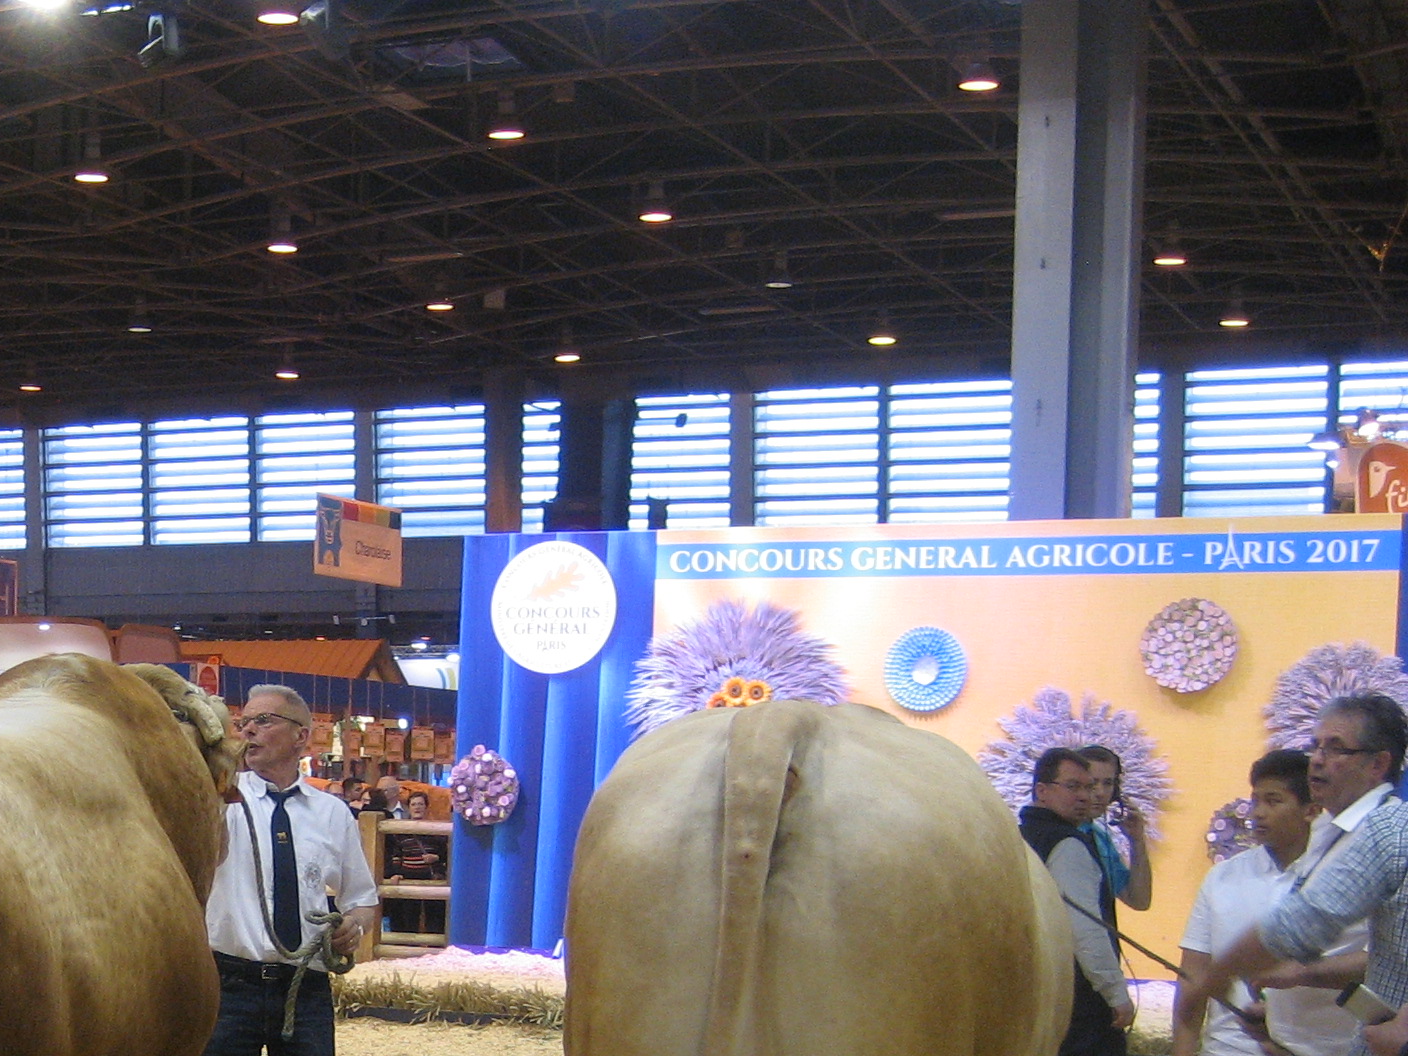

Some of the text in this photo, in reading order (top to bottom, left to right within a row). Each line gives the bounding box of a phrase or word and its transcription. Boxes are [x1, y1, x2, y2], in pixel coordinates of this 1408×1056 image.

[669, 547, 842, 573] CONCOURS
[850, 544, 997, 571] GENERAL
[1005, 542, 1174, 568] AGRICOLE
[1203, 523, 1296, 571] PARIS
[1305, 538, 1381, 564] 2017
[505, 606, 600, 619] CONCOURS
[536, 640, 567, 652] PARIS
